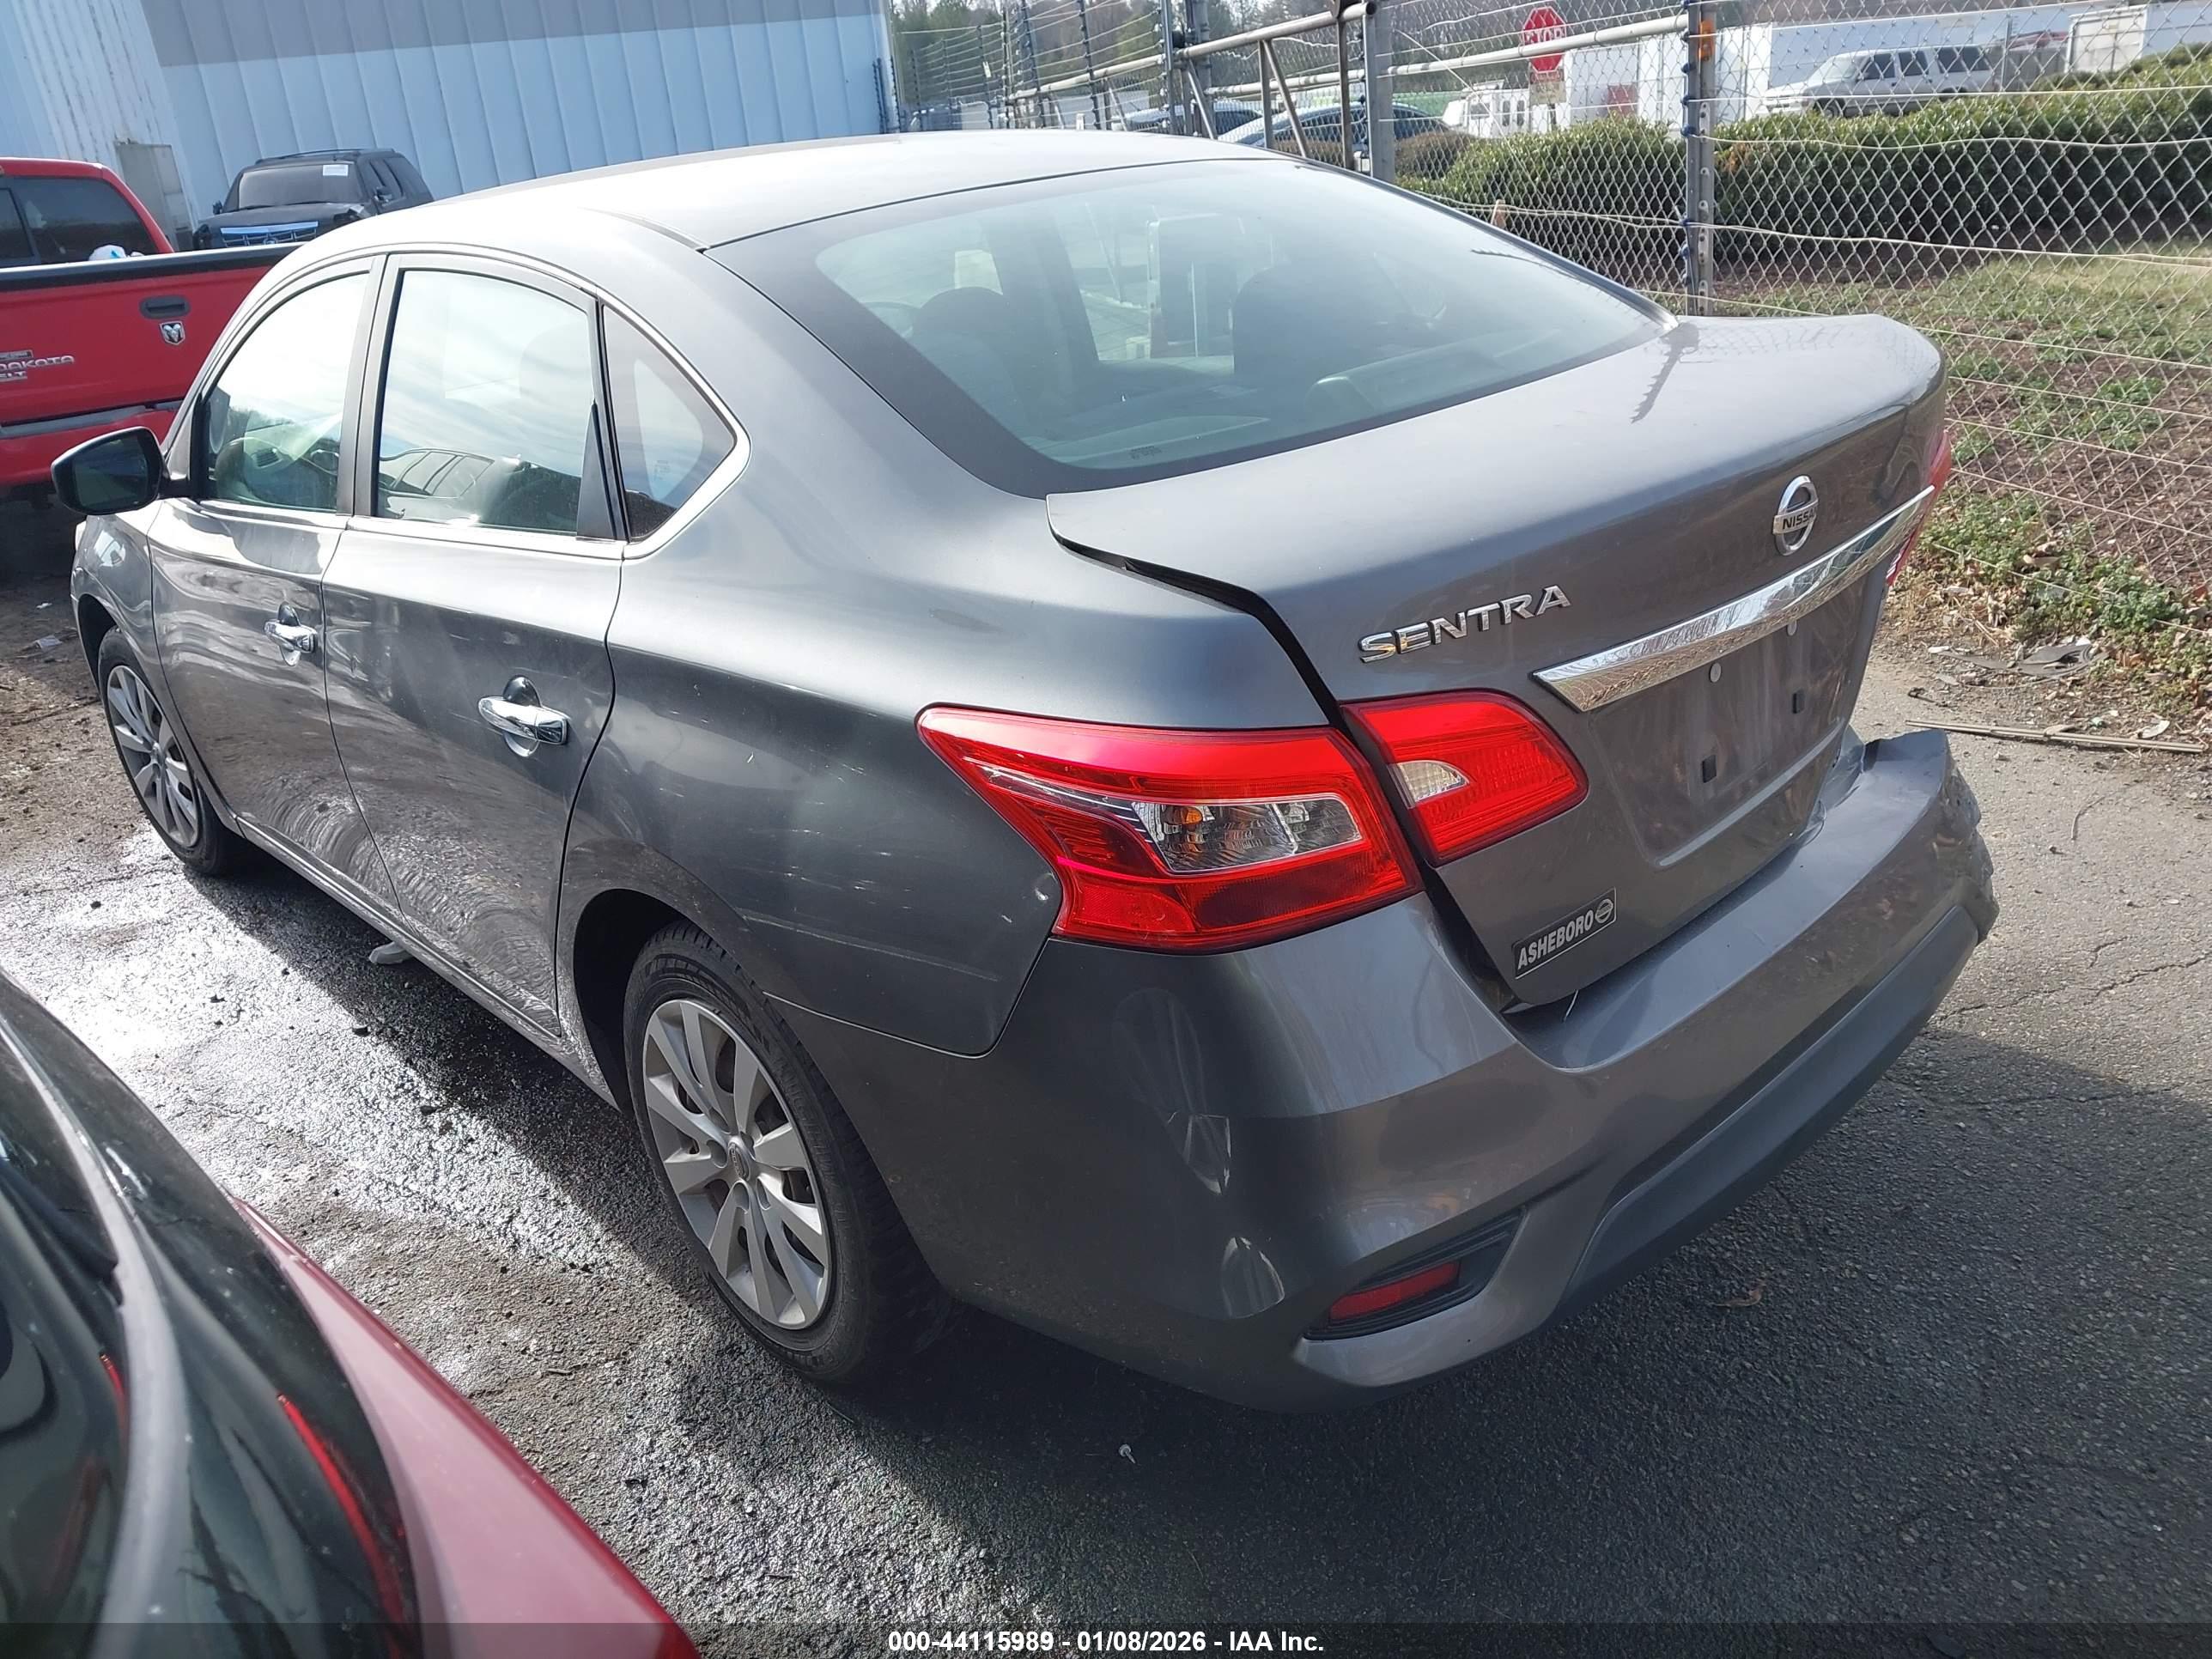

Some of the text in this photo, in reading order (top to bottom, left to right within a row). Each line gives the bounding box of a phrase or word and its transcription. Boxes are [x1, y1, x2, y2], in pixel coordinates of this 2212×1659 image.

[1782, 506, 1818, 530] NISSA
[1358, 584, 1572, 663] SENTRA
[1517, 909, 1594, 970] ASHEBORO
